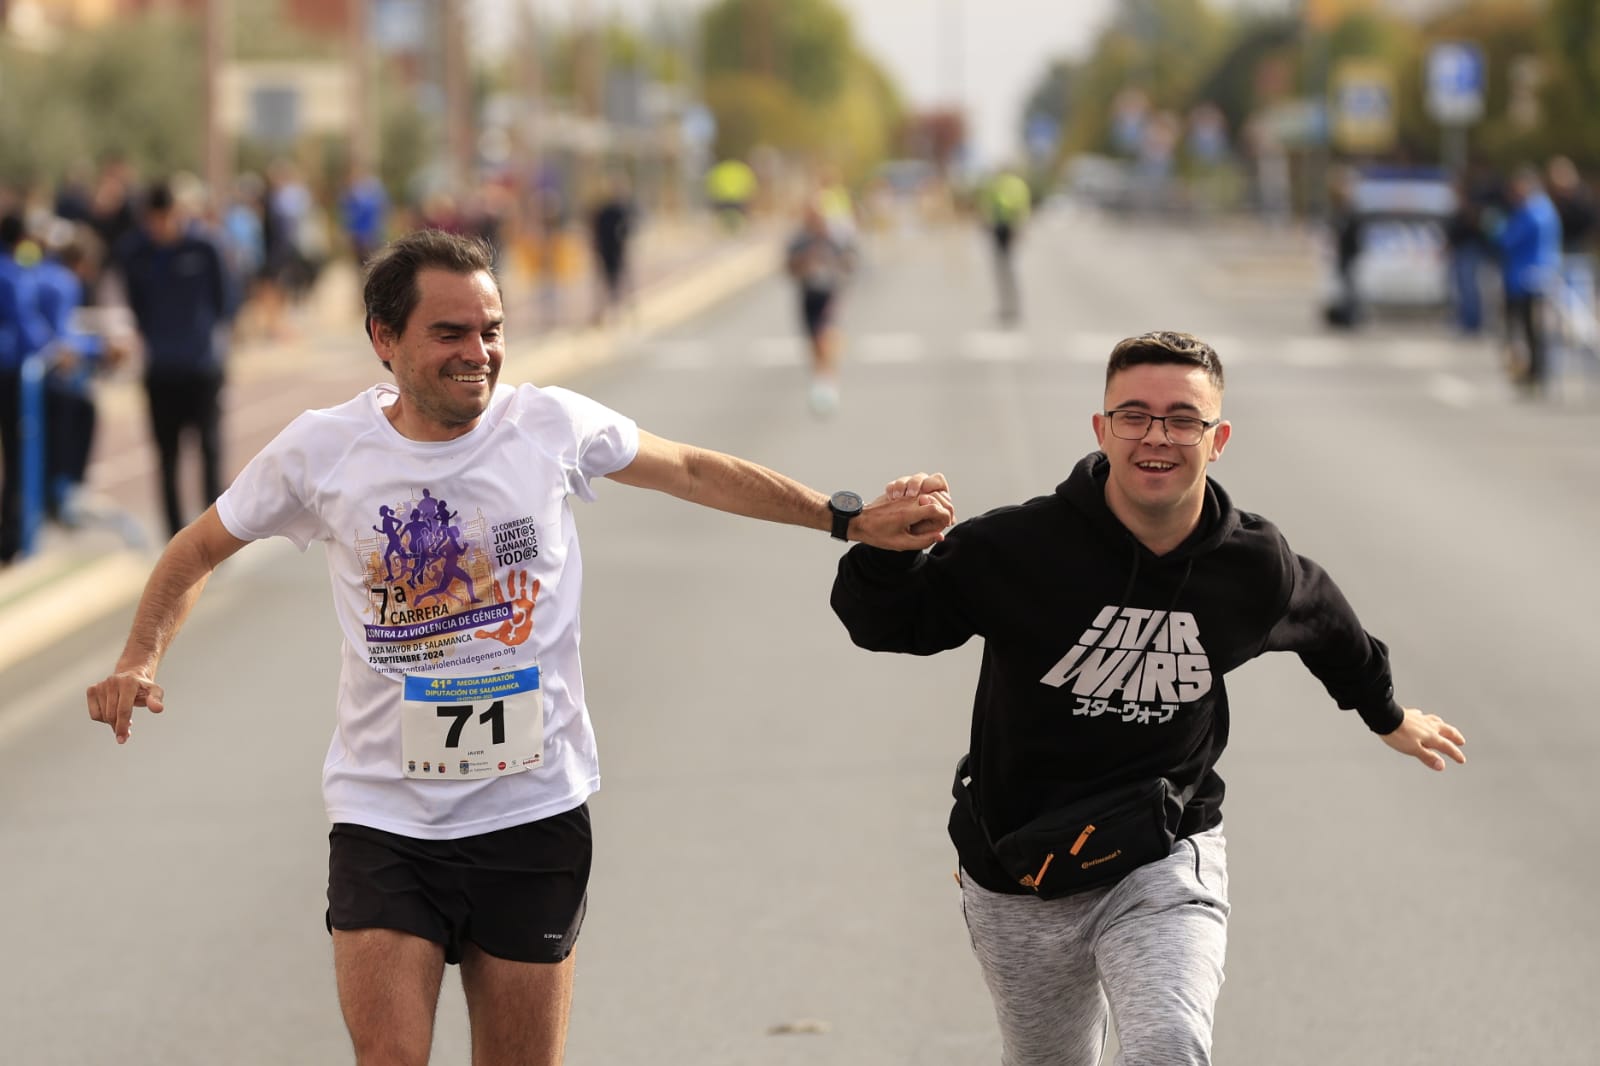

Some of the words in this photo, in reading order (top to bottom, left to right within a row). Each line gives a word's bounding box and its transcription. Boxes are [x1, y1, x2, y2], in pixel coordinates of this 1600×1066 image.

[494, 524, 535, 544] JUNT@S
[499, 516, 533, 531] CORREMOS
[496, 535, 537, 554] GANAMOS
[496, 545, 538, 567] TOD@S
[367, 628, 395, 639] CONTRA
[397, 629, 408, 638] LA
[409, 618, 458, 636] VIOLENCIA
[458, 616, 473, 626] DE
[472, 606, 509, 623] GÉNERO
[391, 603, 449, 625] CARRERA
[1079, 605, 1206, 654] STAR
[385, 644, 411, 654] MAYOR
[413, 643, 423, 651] DE
[424, 633, 472, 649] SALAMANCA
[422, 650, 444, 660] 2024
[456, 679, 479, 687] MEDIA
[480, 673, 515, 684] MARATÓN
[1040, 645, 1212, 703] WARS
[425, 688, 468, 697] DIPUTACIÓN
[479, 682, 520, 695] SALAMANCA
[437, 700, 505, 748] 71
